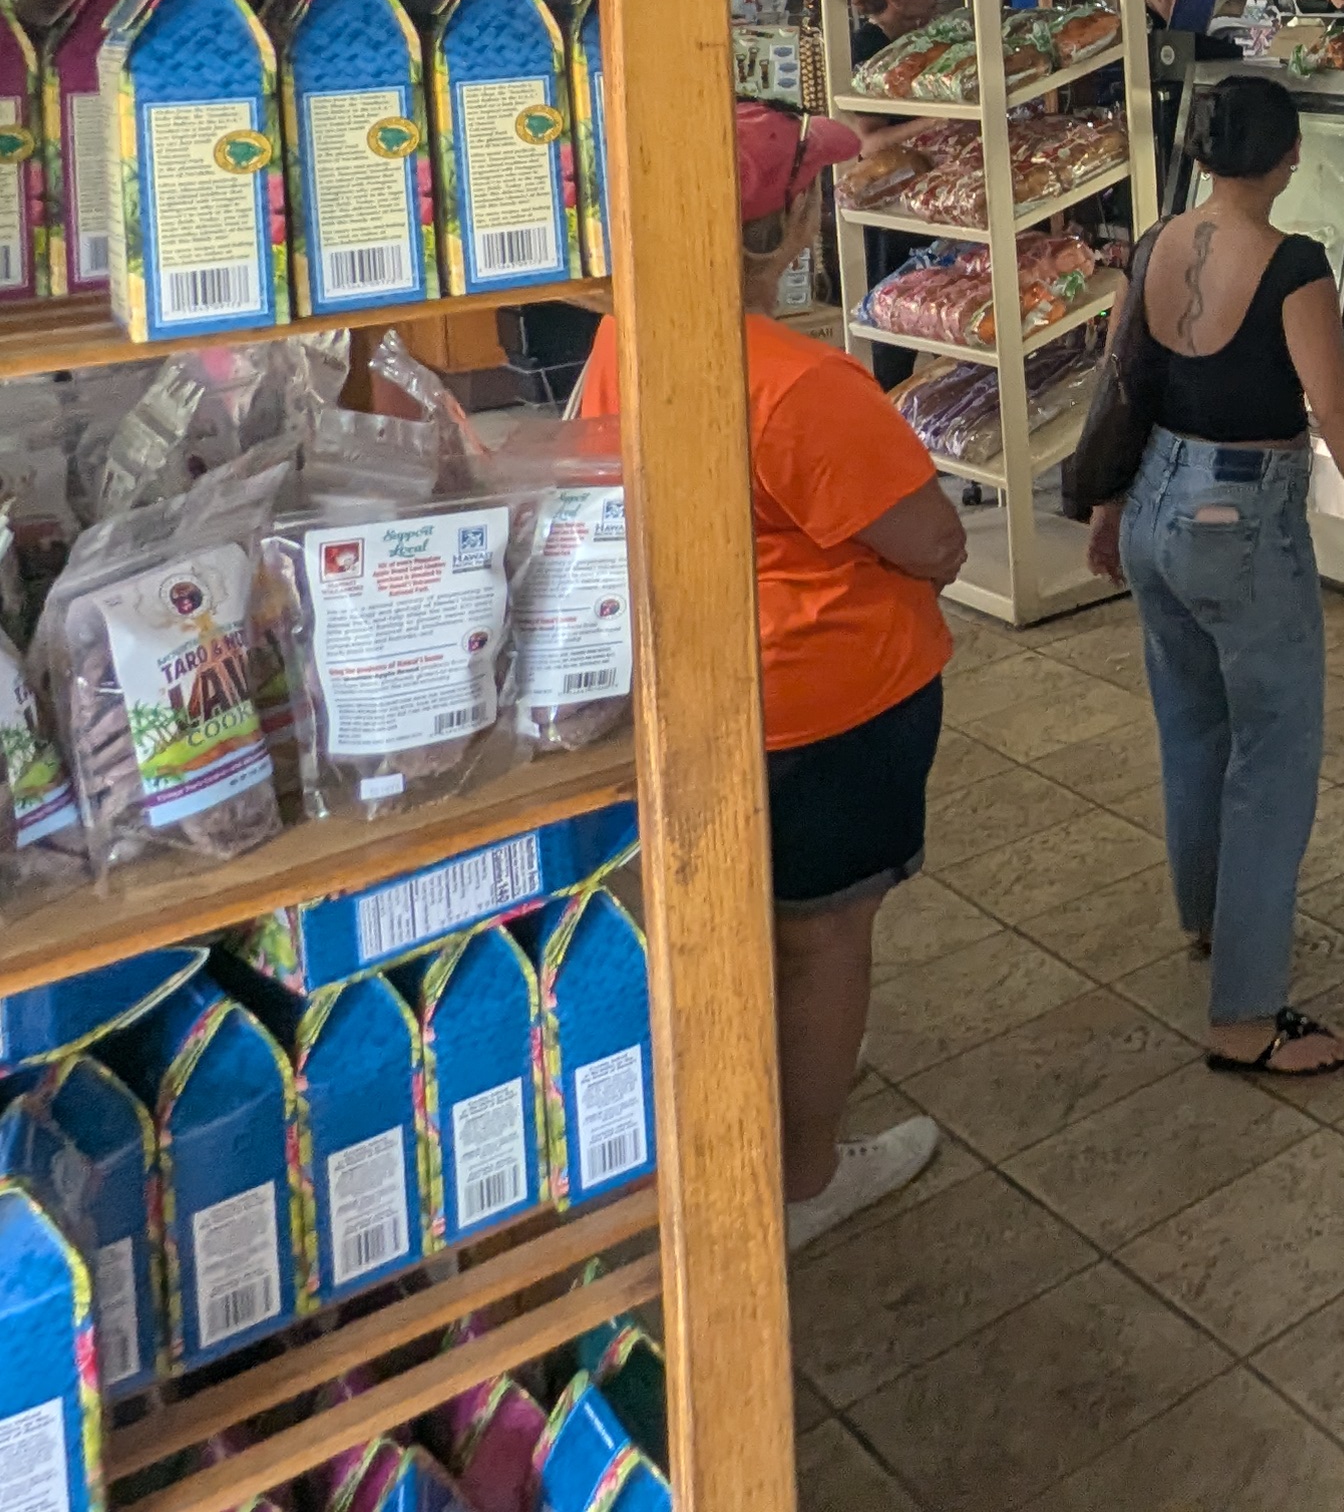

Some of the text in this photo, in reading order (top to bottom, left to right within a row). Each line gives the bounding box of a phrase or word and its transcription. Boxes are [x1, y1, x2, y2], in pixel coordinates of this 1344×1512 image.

[383, 525, 434, 542] Support
[389, 538, 429, 557] Local
[161, 645, 208, 684] TARO
